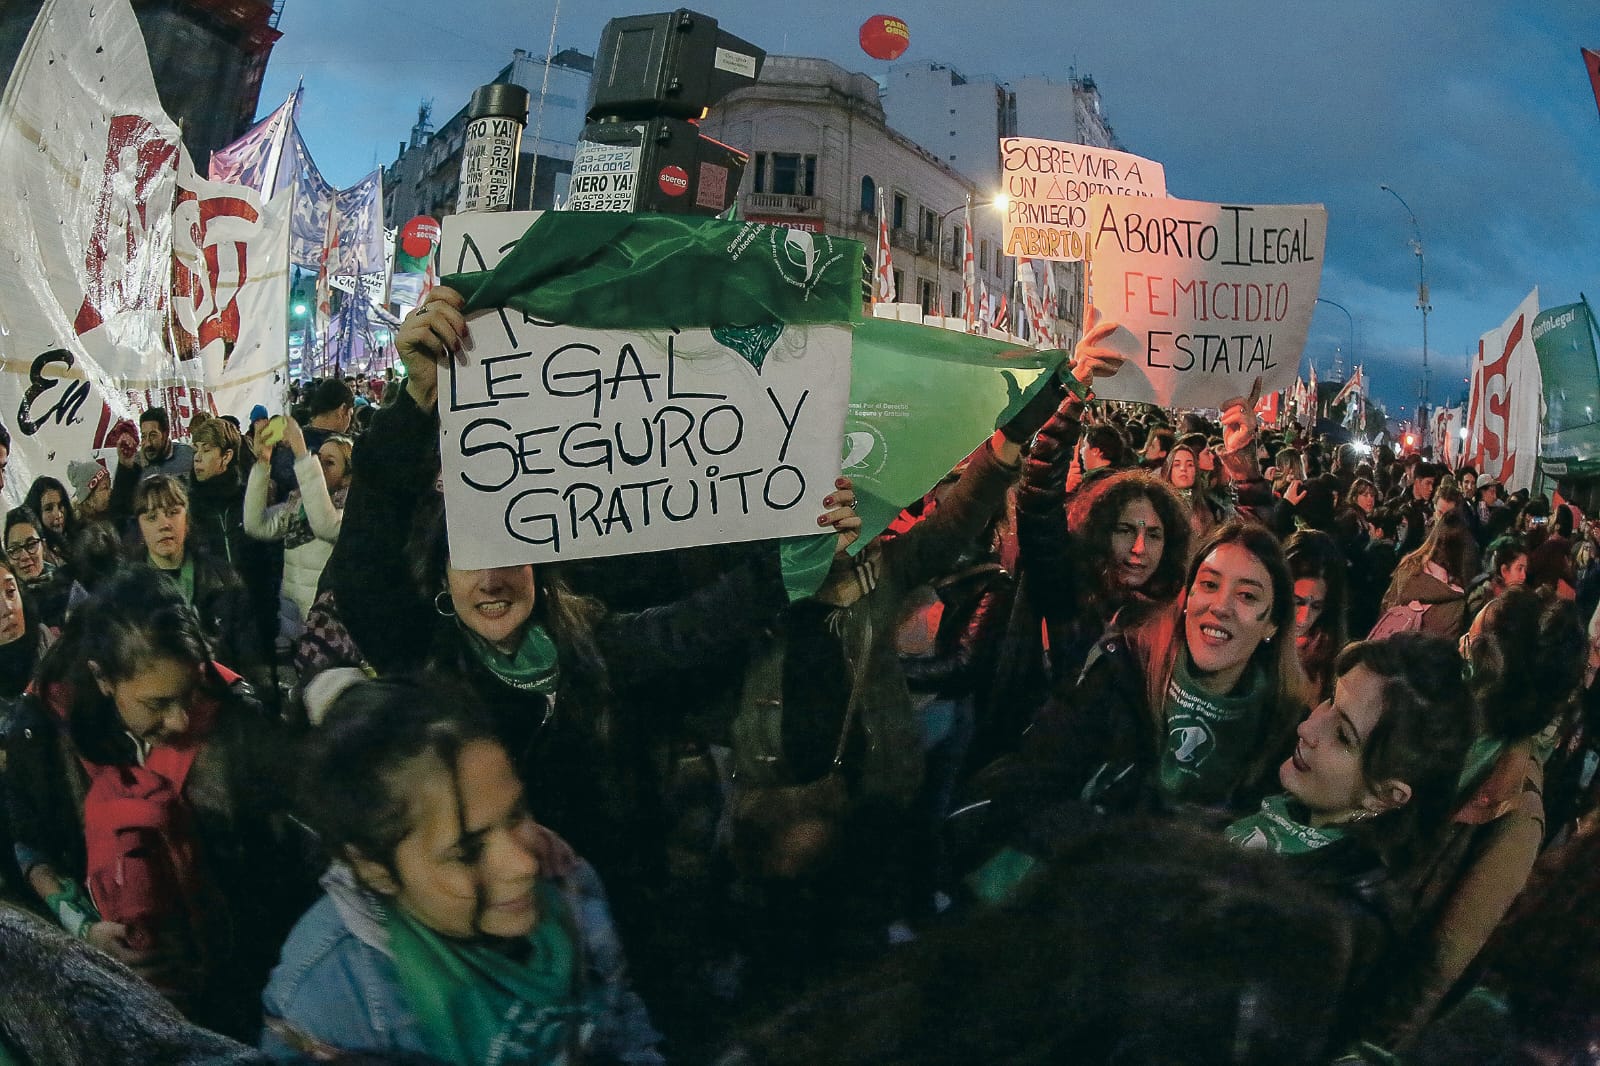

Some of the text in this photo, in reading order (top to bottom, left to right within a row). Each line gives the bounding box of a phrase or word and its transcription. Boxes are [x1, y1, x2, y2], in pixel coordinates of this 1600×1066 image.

[492, 120, 513, 138] YA!
[494, 146, 510, 156] 27
[613, 174, 634, 191] YA!
[660, 174, 687, 186] stereo
[1124, 162, 1143, 184] A
[490, 185, 508, 195] 27
[1010, 176, 1036, 198] UN
[1007, 226, 1083, 257] ABORTO
[1095, 204, 1314, 266] ABORTO ILEGAL
[1124, 272, 1289, 322] FEMICIDIO
[1147, 330, 1278, 374] ESTATAL
[449, 336, 728, 418] LEGAL
[17, 349, 91, 436] En
[460, 405, 744, 492] SEGURO
[767, 387, 809, 463] Y
